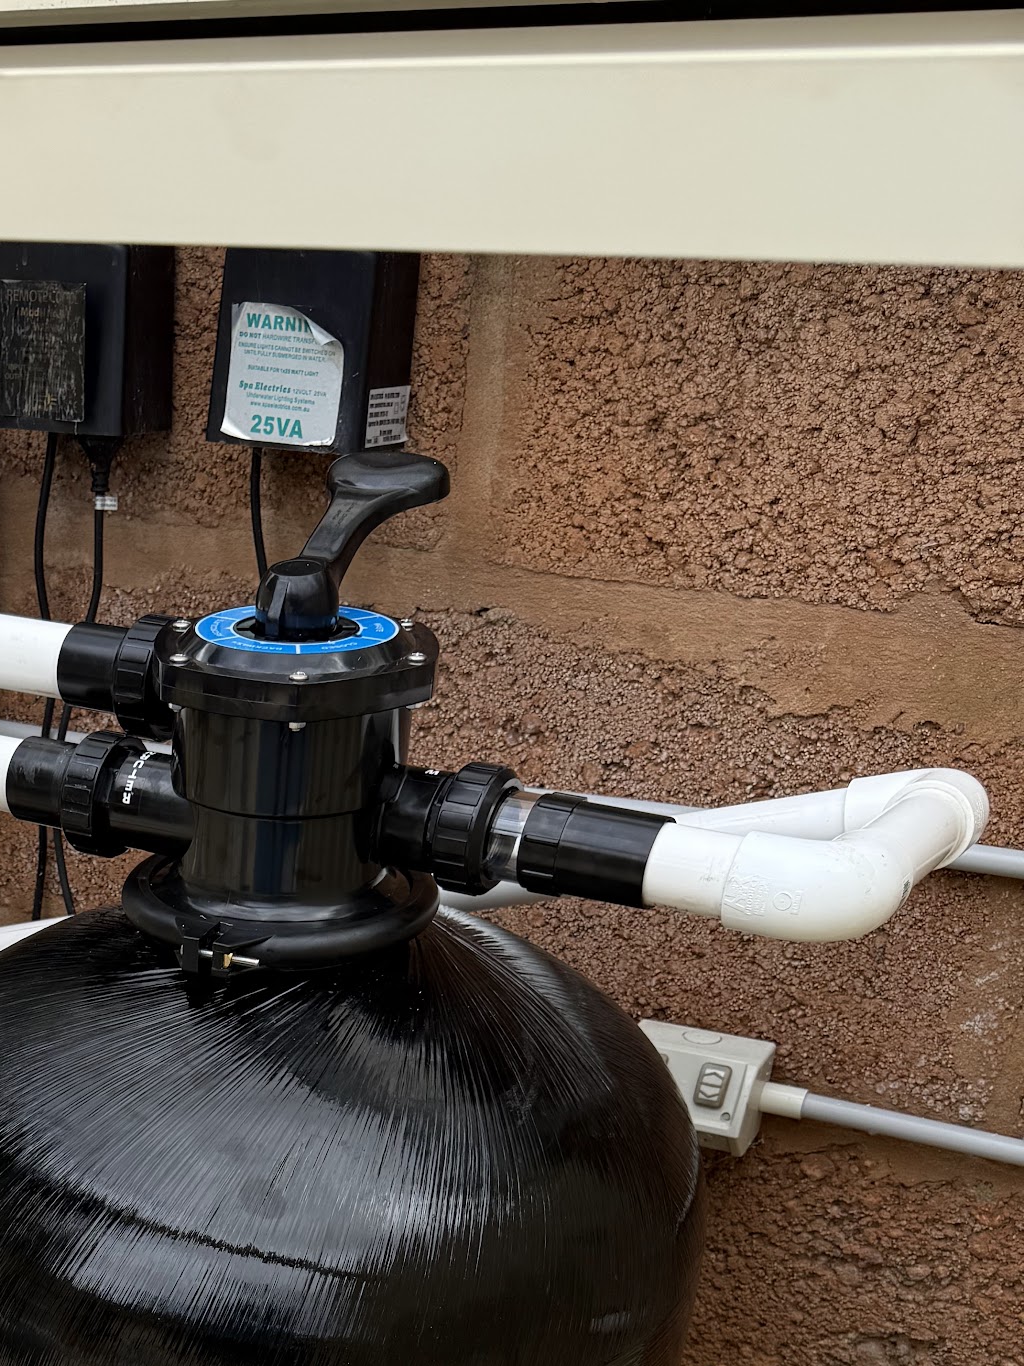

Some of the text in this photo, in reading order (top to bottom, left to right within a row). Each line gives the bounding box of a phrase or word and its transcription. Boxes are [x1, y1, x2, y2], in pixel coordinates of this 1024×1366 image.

[239, 380, 253, 390] Spa
[254, 382, 291, 394] Electrics
[246, 392, 315, 405] Underwater Lighting Systems
[250, 414, 303, 438] 25VA
